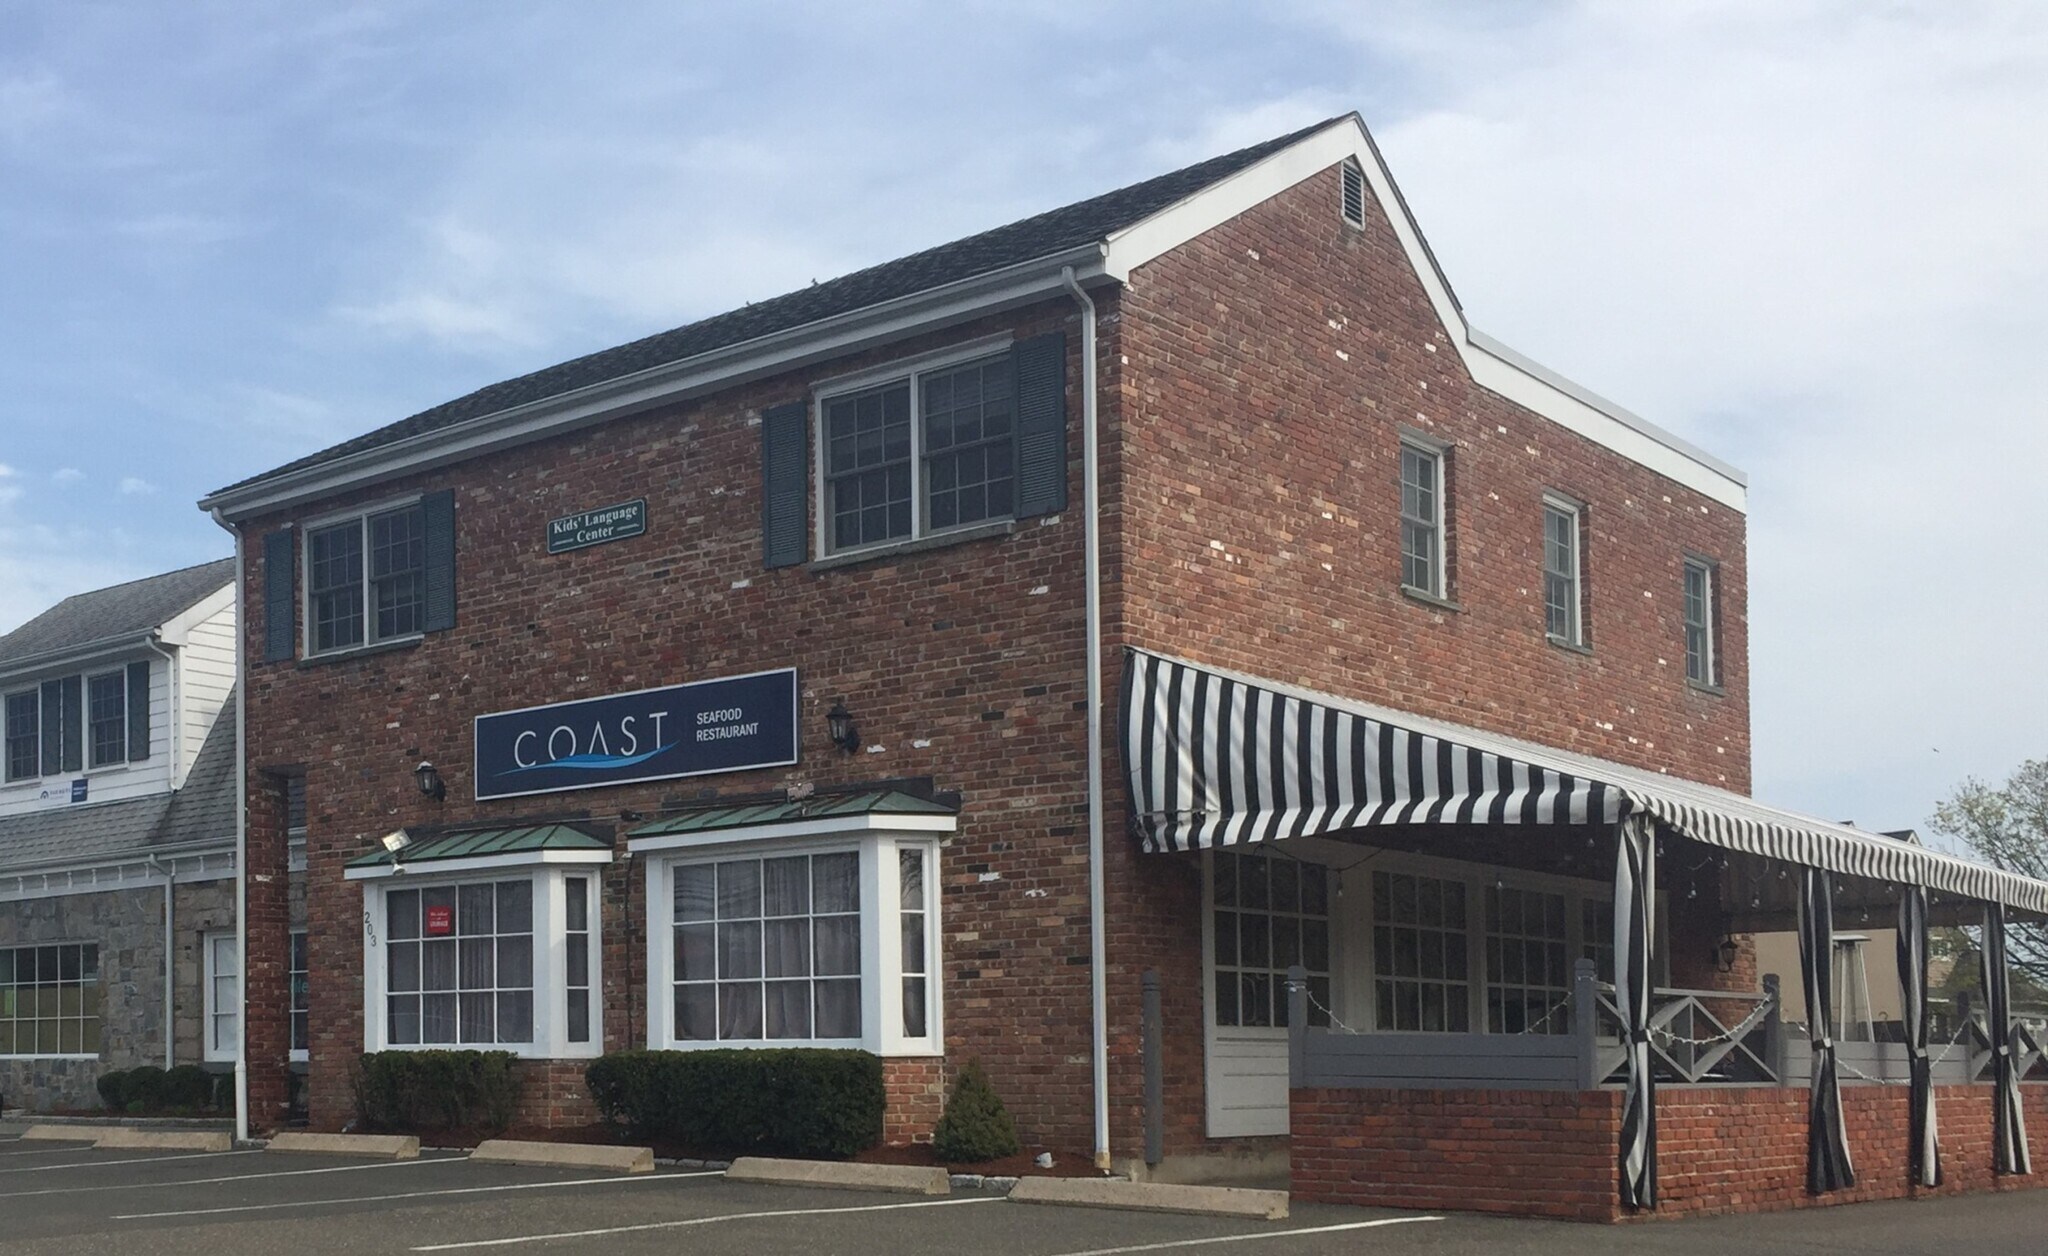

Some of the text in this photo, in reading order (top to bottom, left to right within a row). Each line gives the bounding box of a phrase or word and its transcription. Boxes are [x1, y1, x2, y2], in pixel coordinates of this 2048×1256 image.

[553, 506, 638, 534] Kids' Language
[576, 526, 614, 543] Center
[696, 707, 743, 725] SEAFOOD
[514, 711, 668, 768] COAST
[696, 722, 759, 742] RESTAURANT
[364, 911, 377, 947] 203
